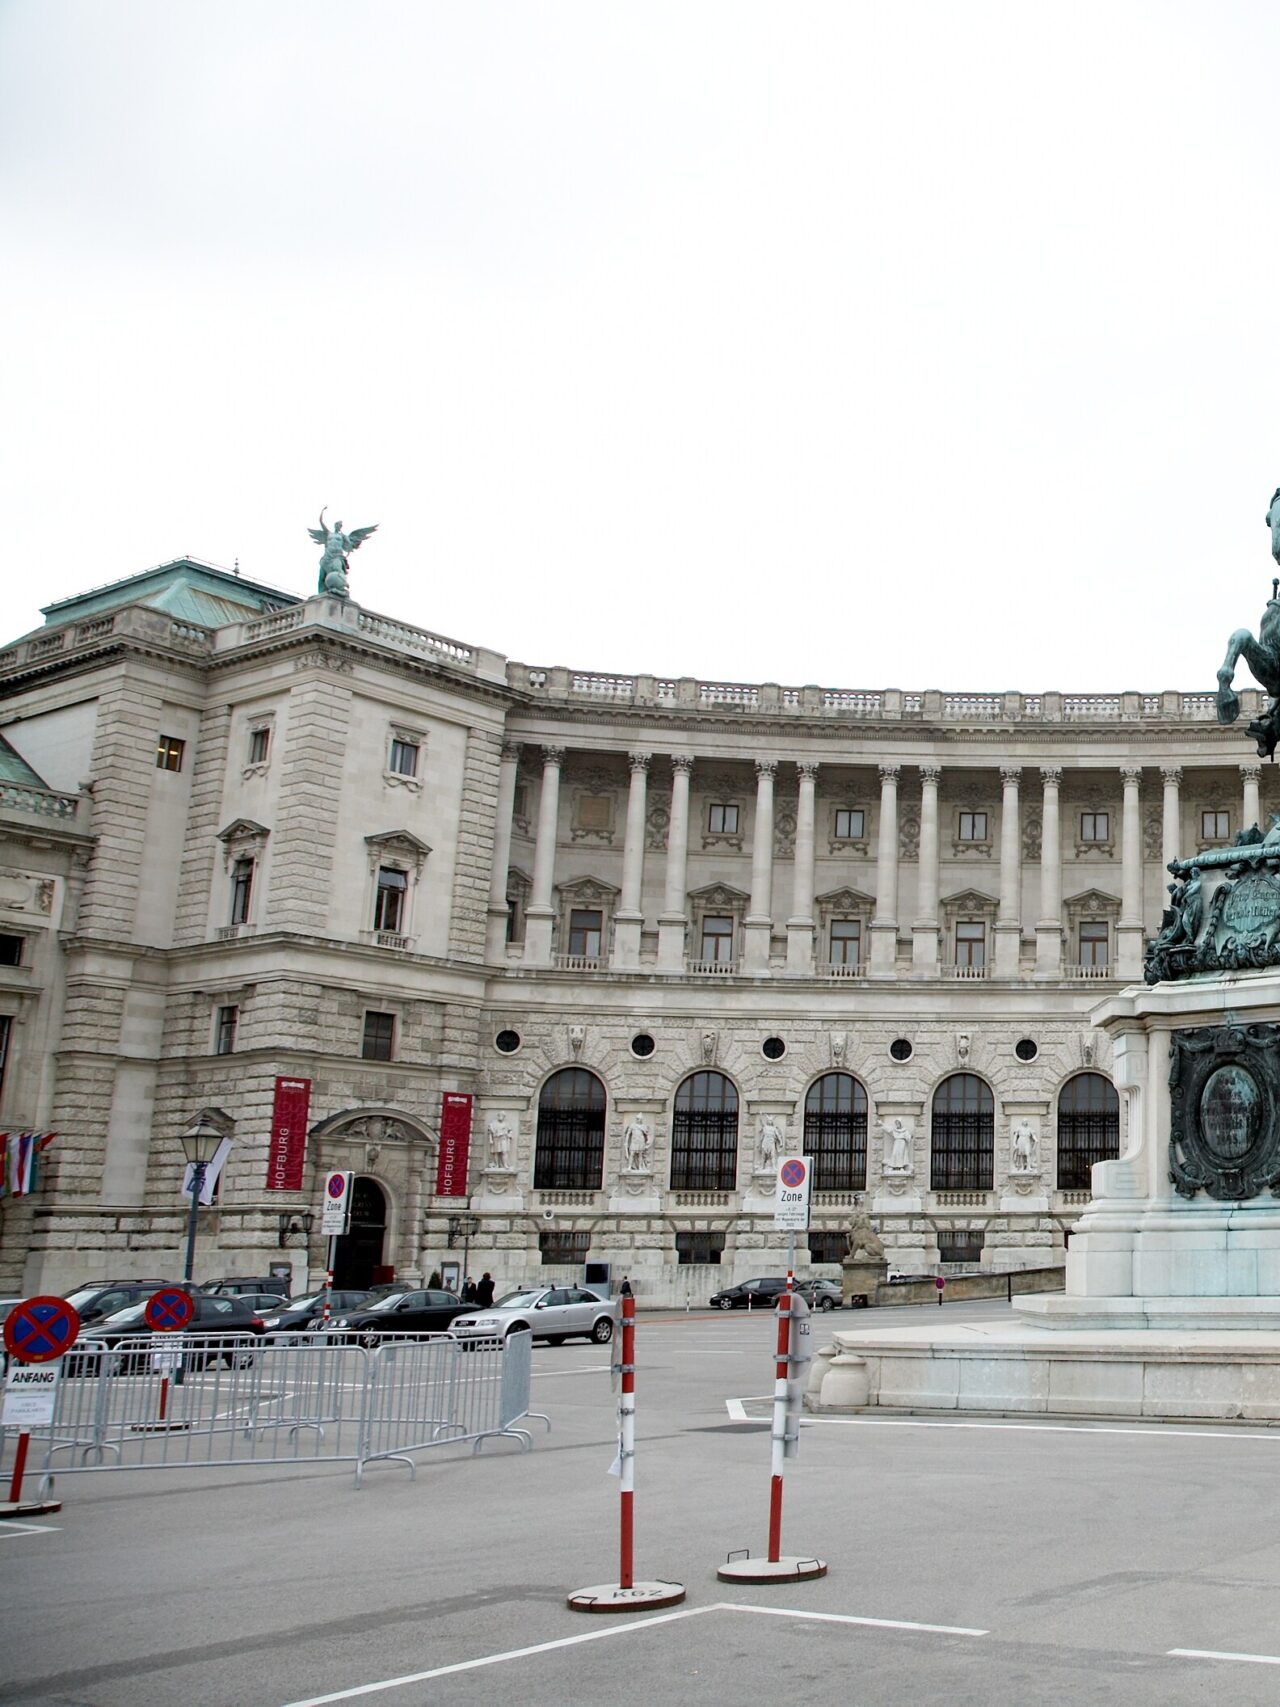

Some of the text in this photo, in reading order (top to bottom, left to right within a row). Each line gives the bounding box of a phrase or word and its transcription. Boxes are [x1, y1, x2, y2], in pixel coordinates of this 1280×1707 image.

[275, 1127, 289, 1189] HOFBURG
[443, 1138, 455, 1195] HOFBURG
[781, 1190, 803, 1202] Zone
[327, 1200, 342, 1211] Zone
[12, 1372, 55, 1384] ANFANG
